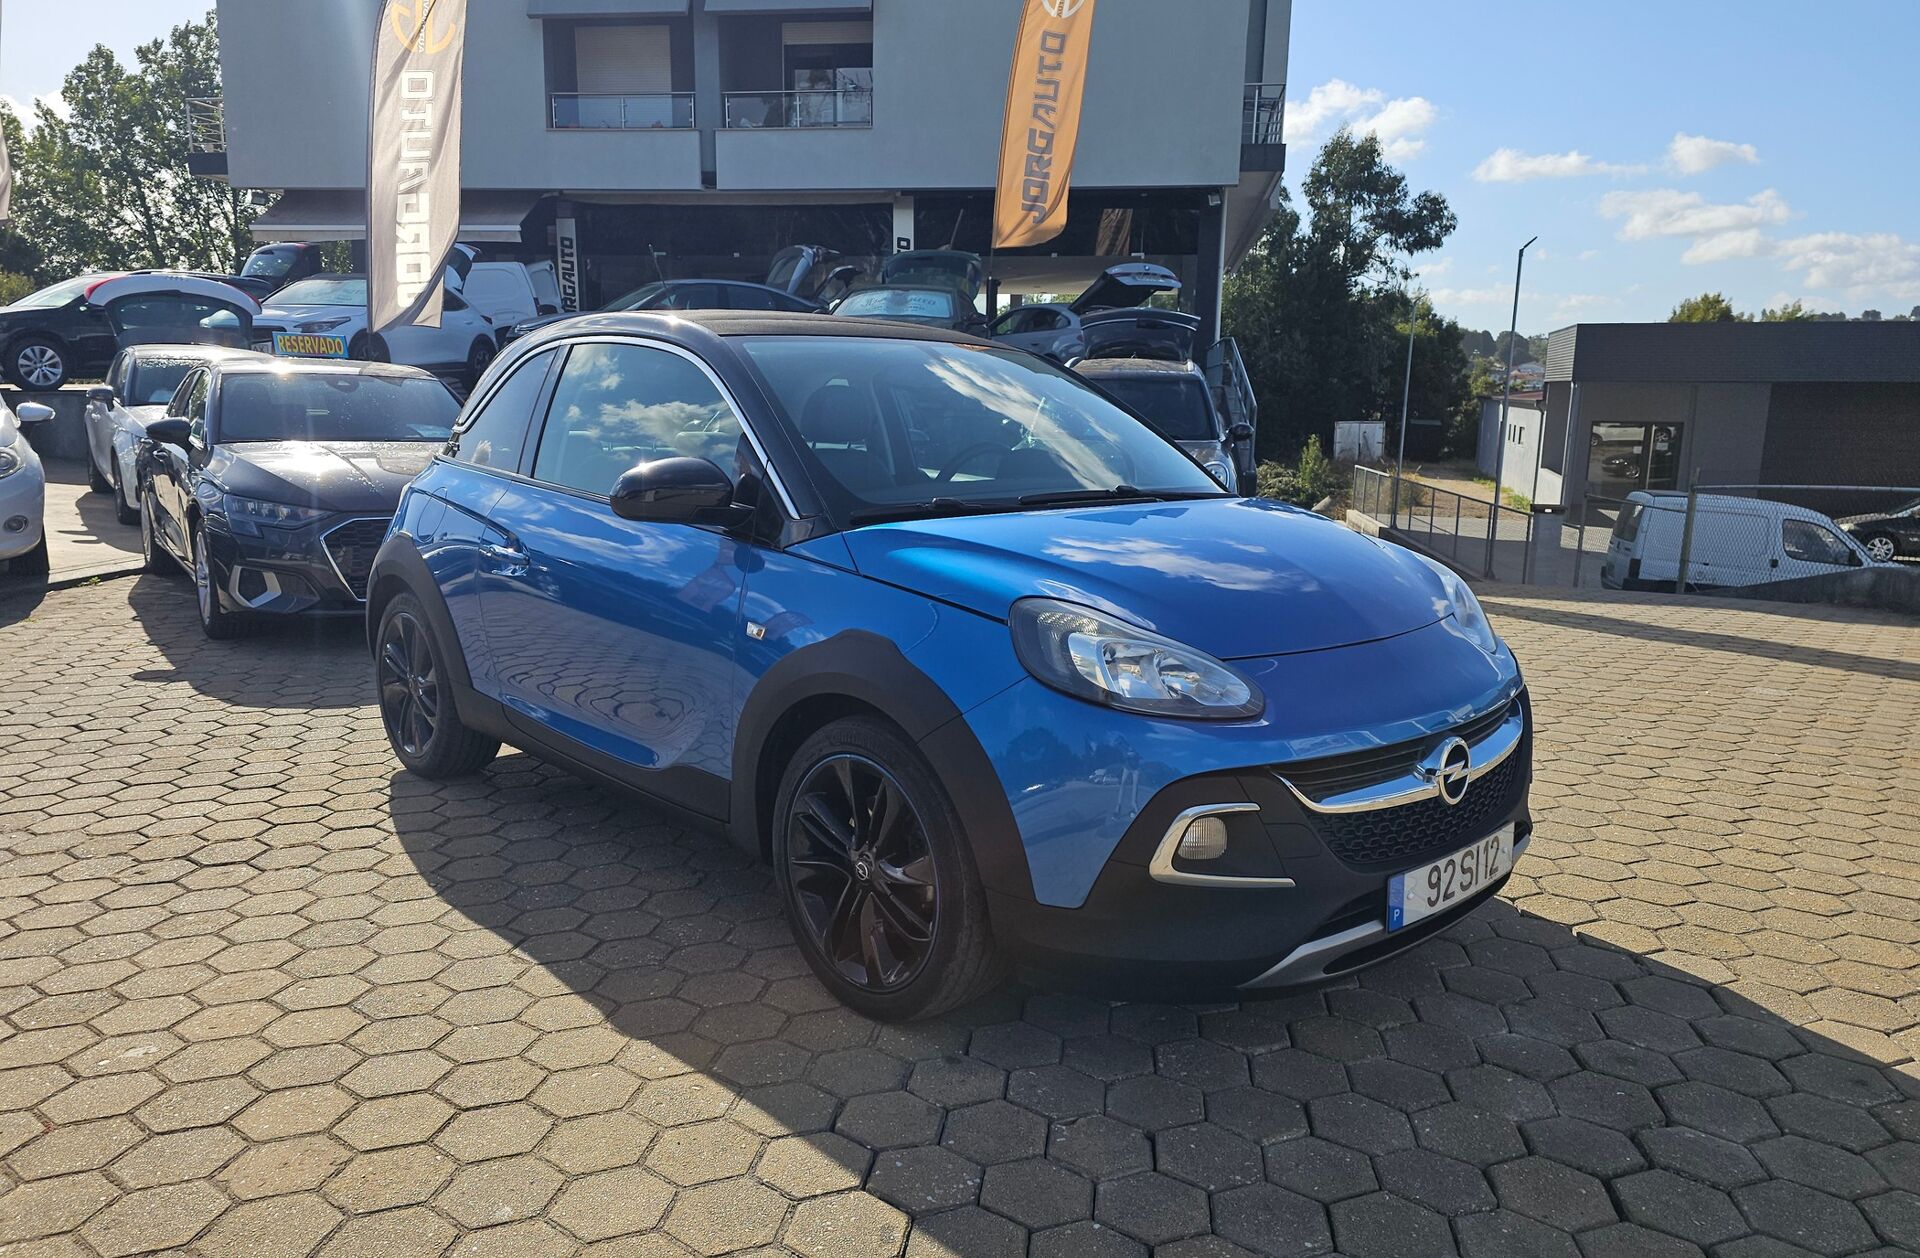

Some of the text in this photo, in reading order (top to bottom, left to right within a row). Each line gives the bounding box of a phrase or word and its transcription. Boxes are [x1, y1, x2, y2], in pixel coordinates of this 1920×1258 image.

[1021, 30, 1066, 224] JORGAUTO
[560, 236, 577, 312] RGAUTO
[277, 335, 344, 355] RESERVADO
[1393, 908, 1400, 921] P
